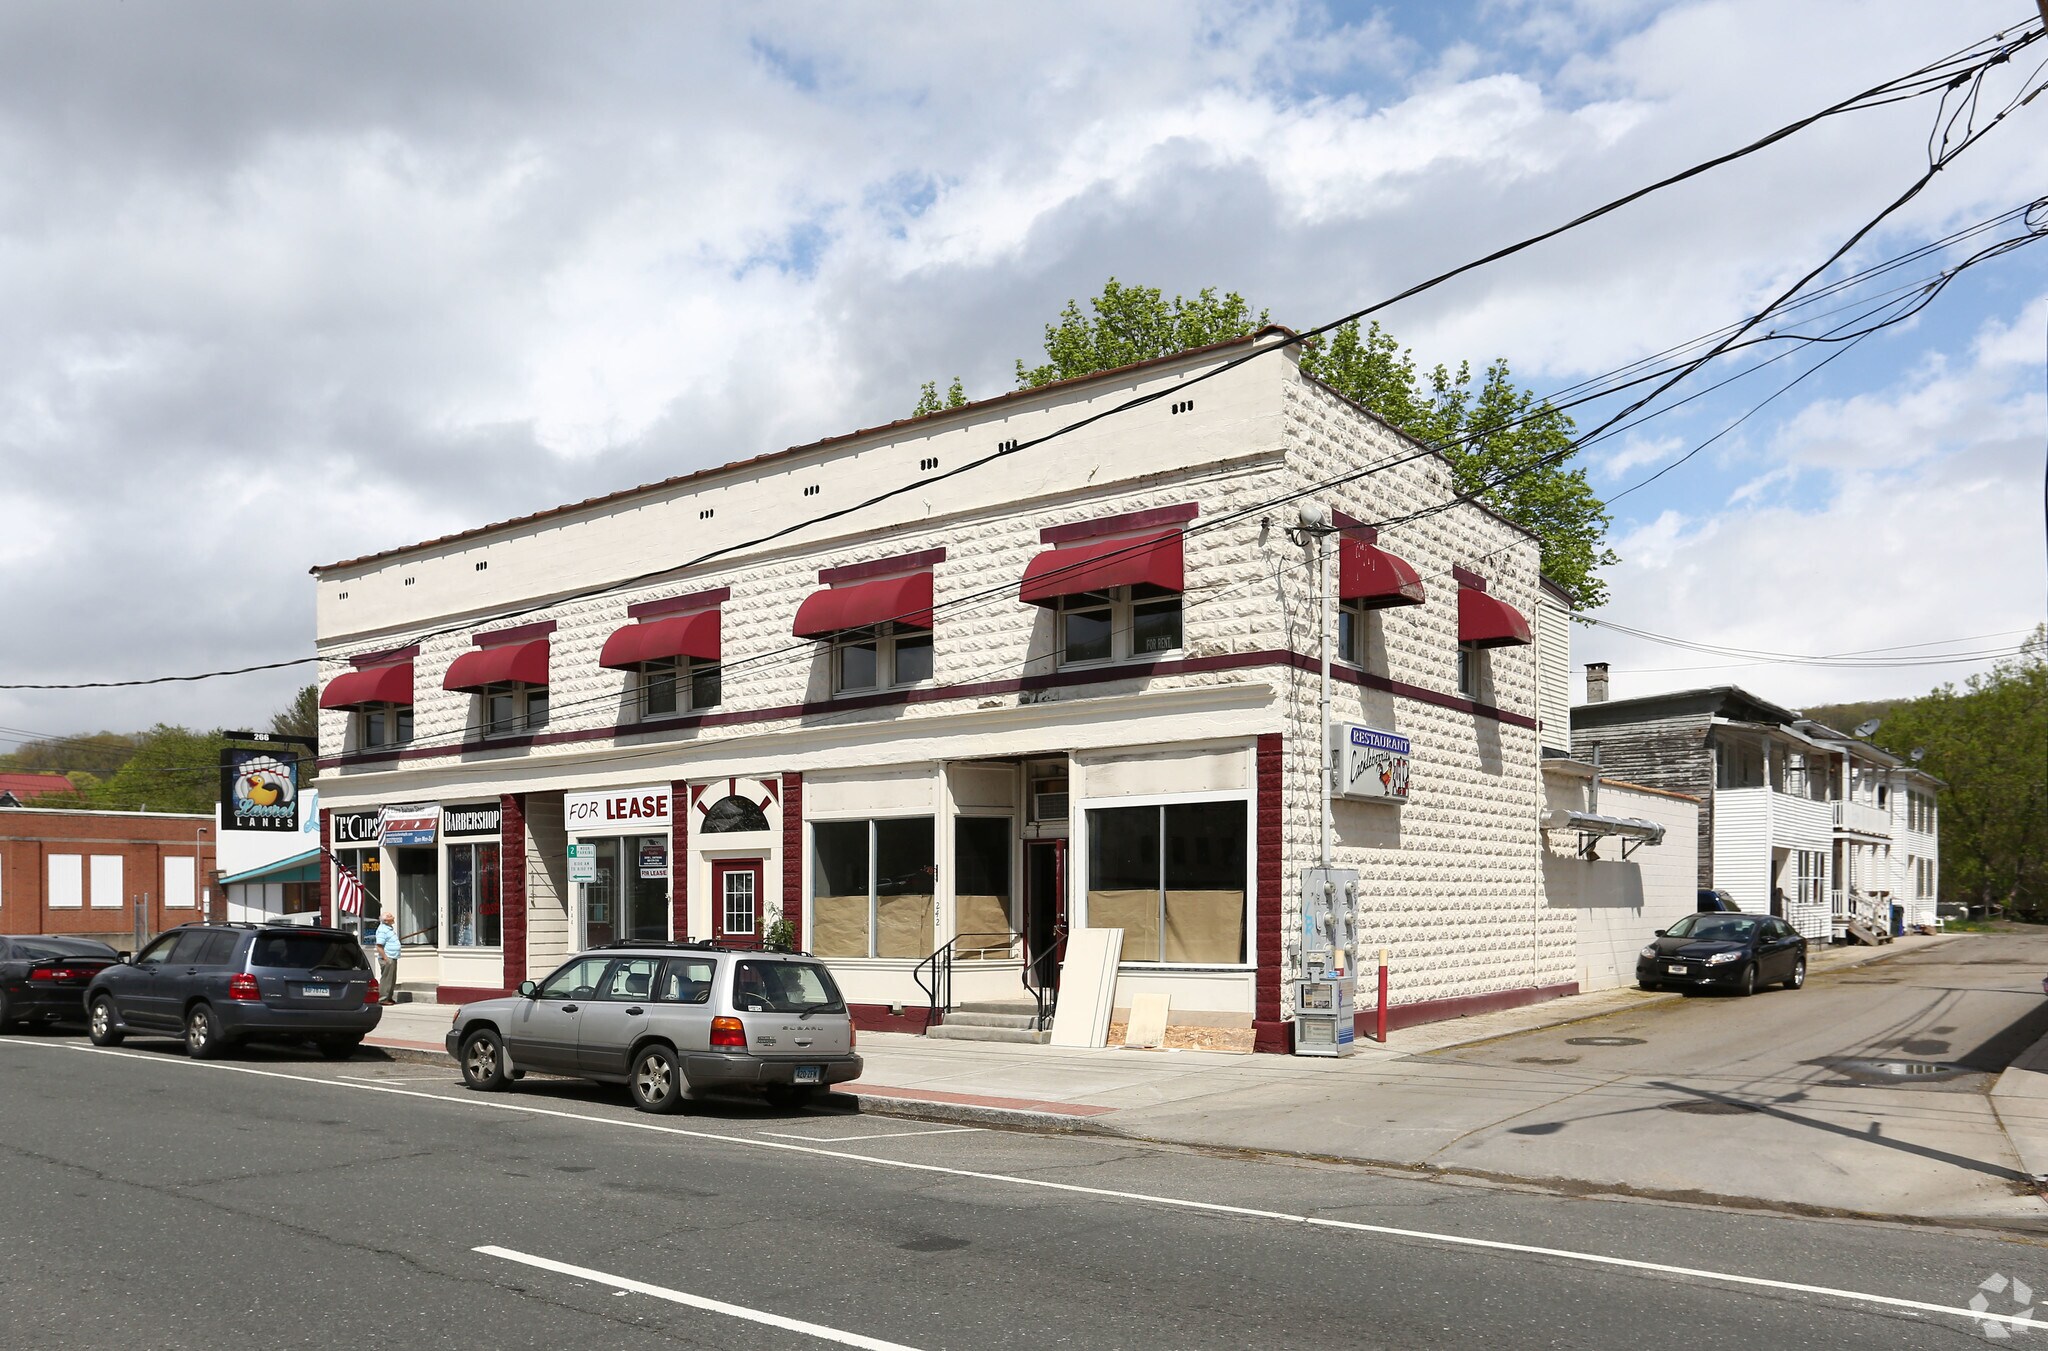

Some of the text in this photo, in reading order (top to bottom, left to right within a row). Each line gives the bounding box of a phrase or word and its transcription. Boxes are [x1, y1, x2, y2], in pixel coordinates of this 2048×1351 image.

[254, 733, 270, 741] 266
[1353, 729, 1409, 752] RESTAURANT
[234, 798, 296, 818] Laurel
[569, 795, 668, 820] FOR LEASE
[236, 817, 294, 828] LANES
[444, 810, 499, 832] BARBERSHOP
[570, 847, 575, 855] 2
